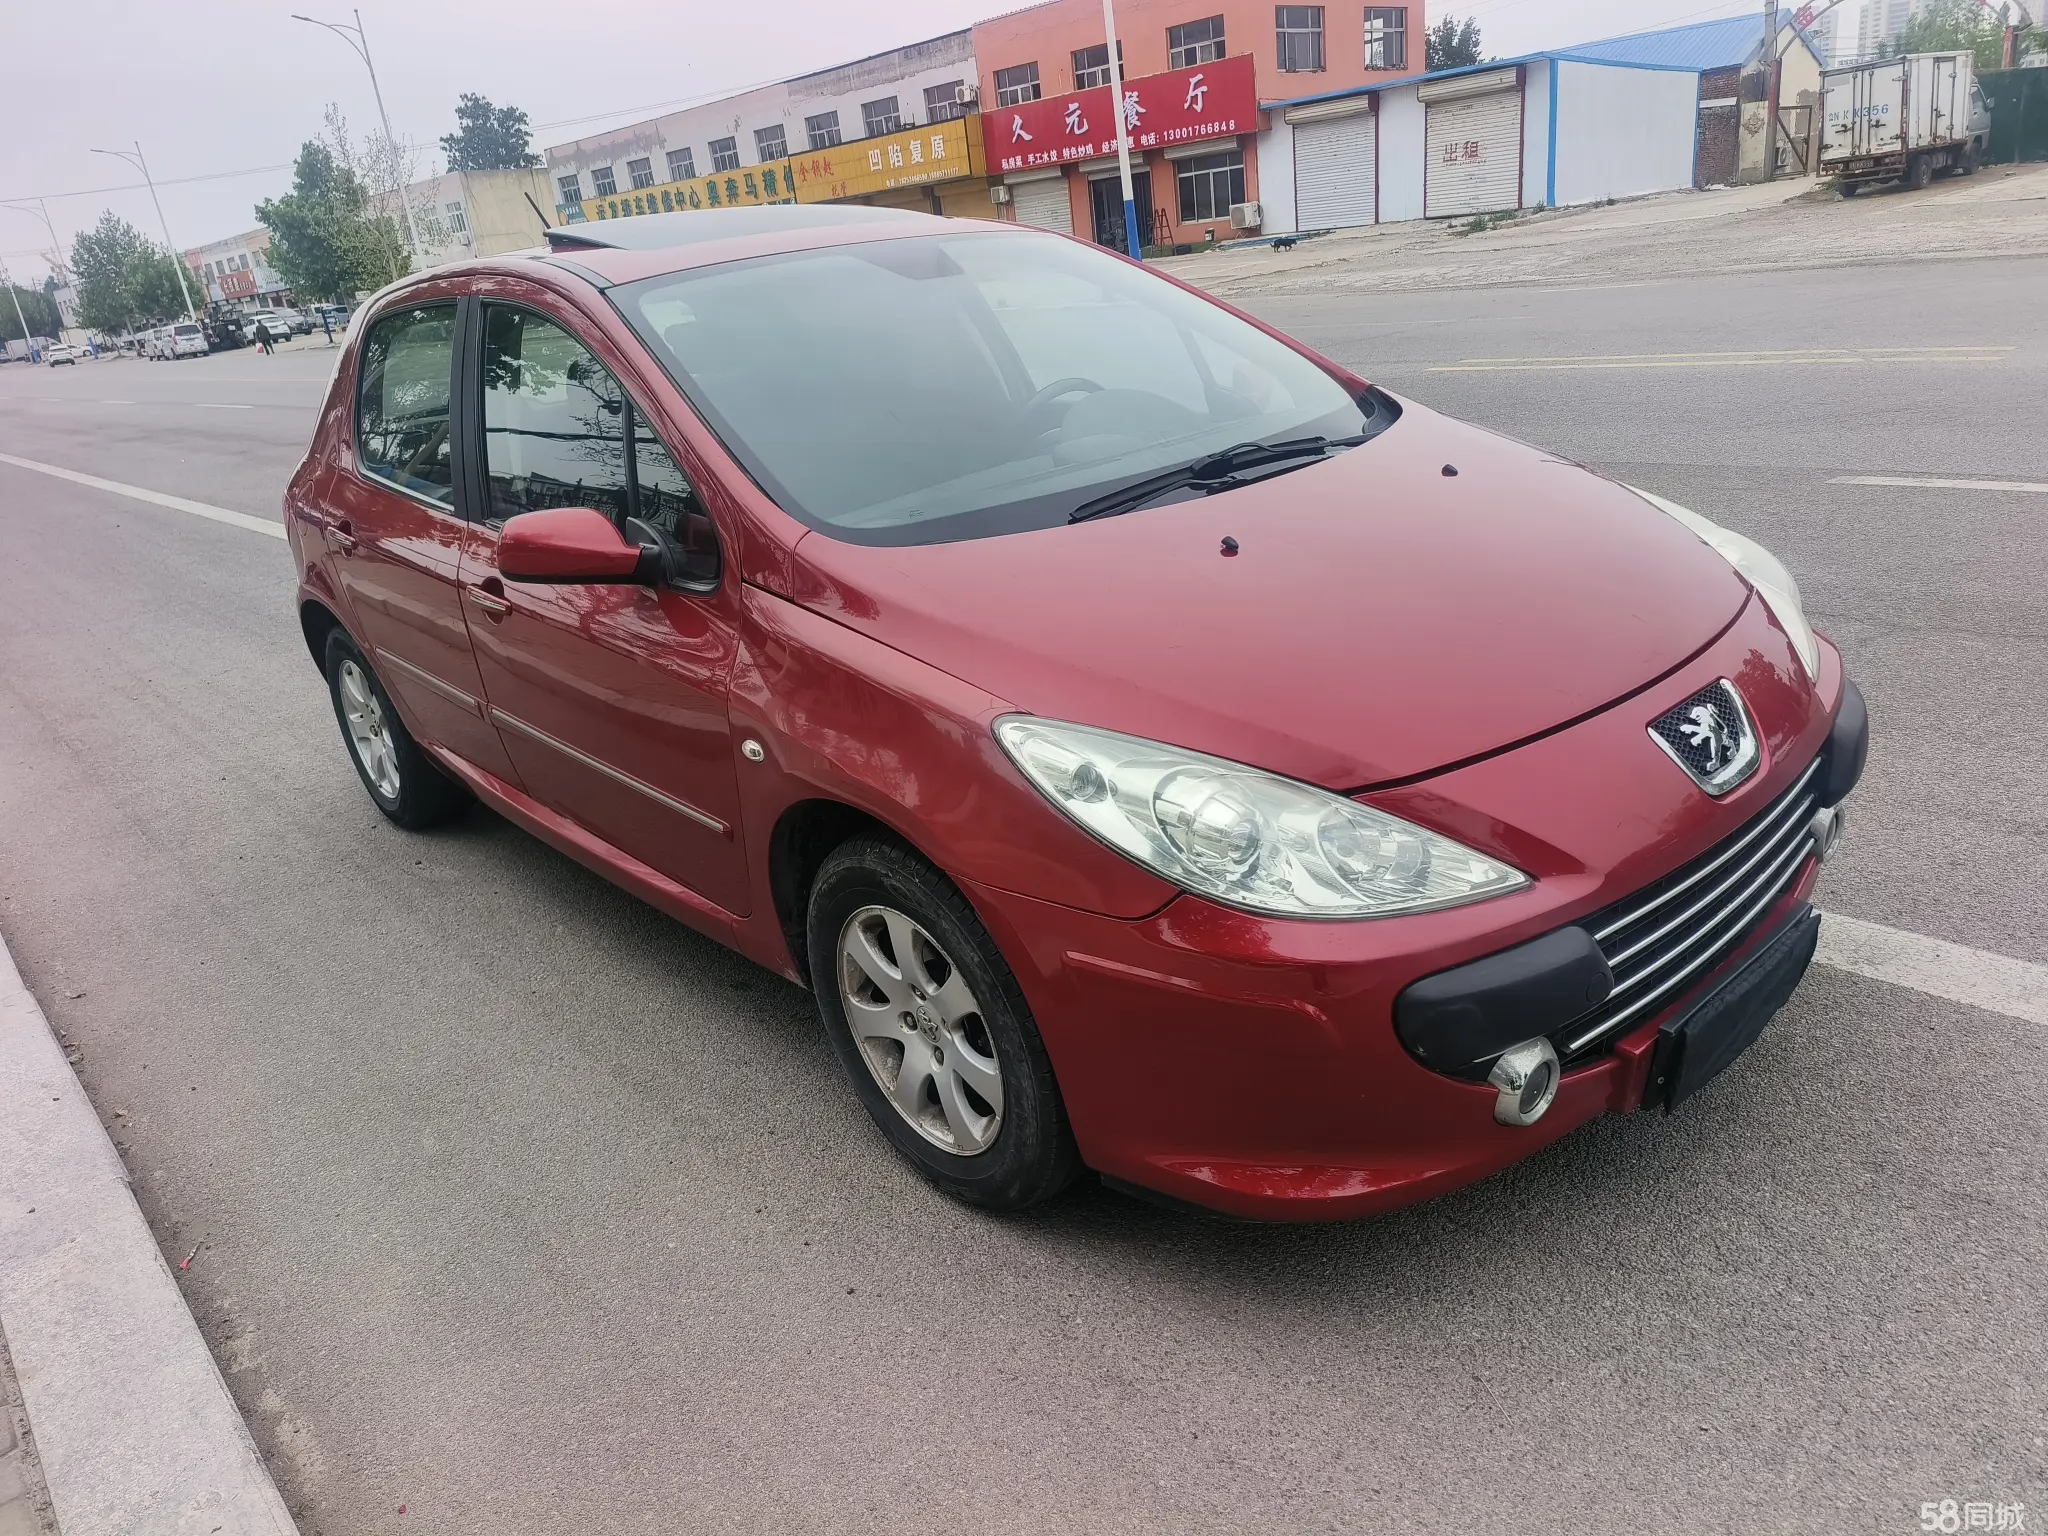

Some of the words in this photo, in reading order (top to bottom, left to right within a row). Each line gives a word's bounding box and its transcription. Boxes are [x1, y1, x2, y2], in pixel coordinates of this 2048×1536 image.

[1012, 73, 1208, 144] 久元餐厅
[868, 134, 946, 172] 凹陷复原
[1027, 149, 1058, 166] 手工水饺
[1062, 143, 1094, 160] 特色炒鸡
[1101, 135, 1135, 153] 经济惠
[1163, 119, 1236, 142] 13001766848
[1442, 140, 1480, 163] 出租
